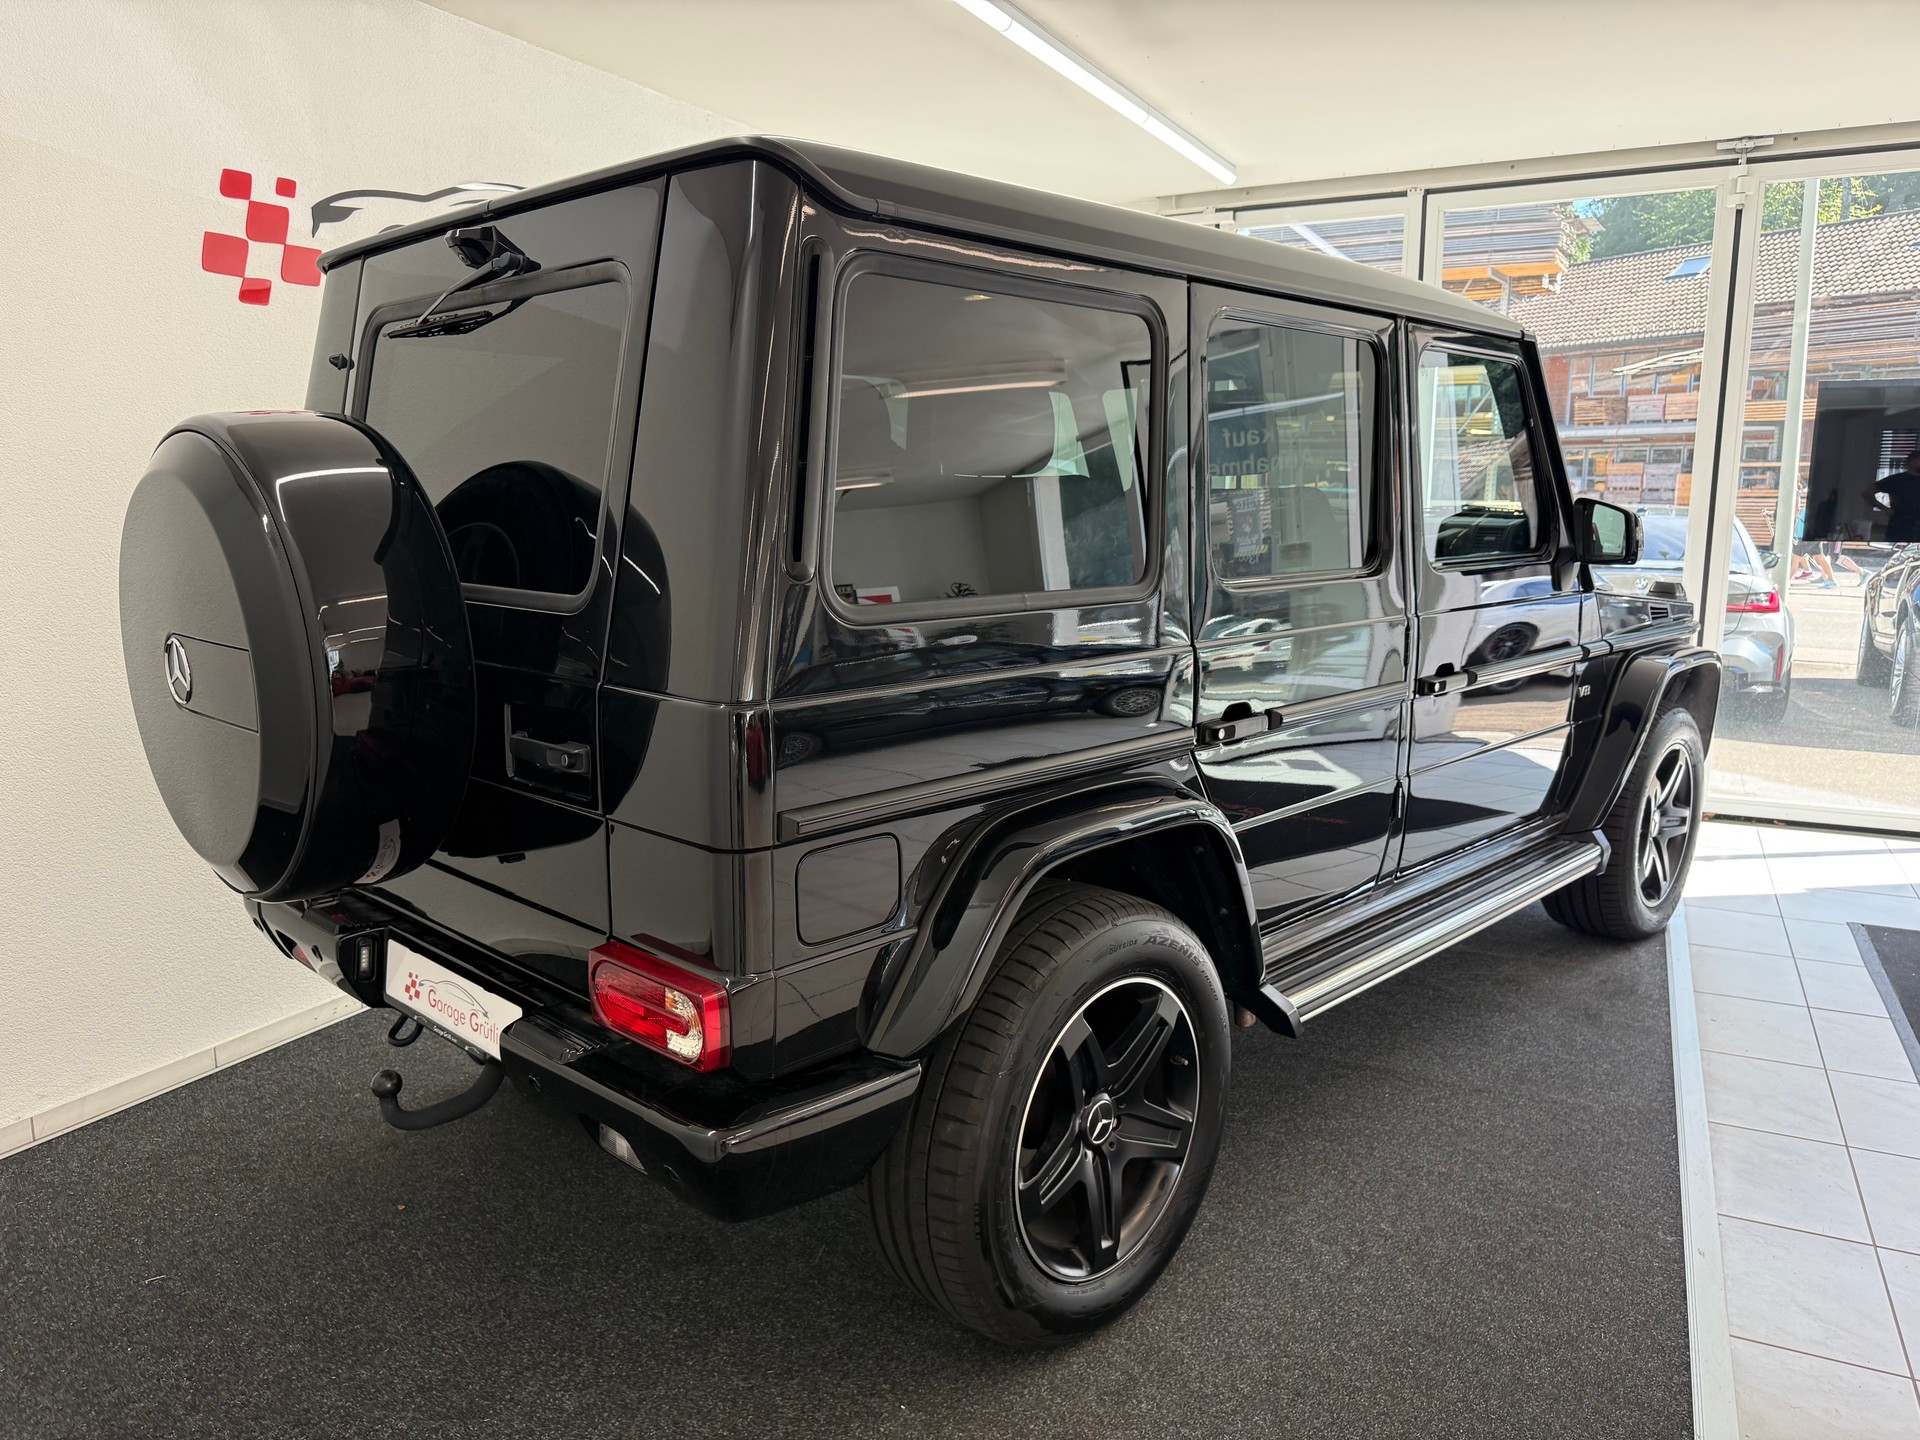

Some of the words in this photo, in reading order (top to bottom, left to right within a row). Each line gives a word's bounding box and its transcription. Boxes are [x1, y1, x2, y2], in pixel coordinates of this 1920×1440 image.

[1579, 685, 1591, 698] V8
[1108, 939, 1138, 955] OUTSIDE
[1143, 935, 1201, 967] AZENIS
[428, 988, 466, 1027] Garage
[469, 1011, 499, 1045] Grütli
